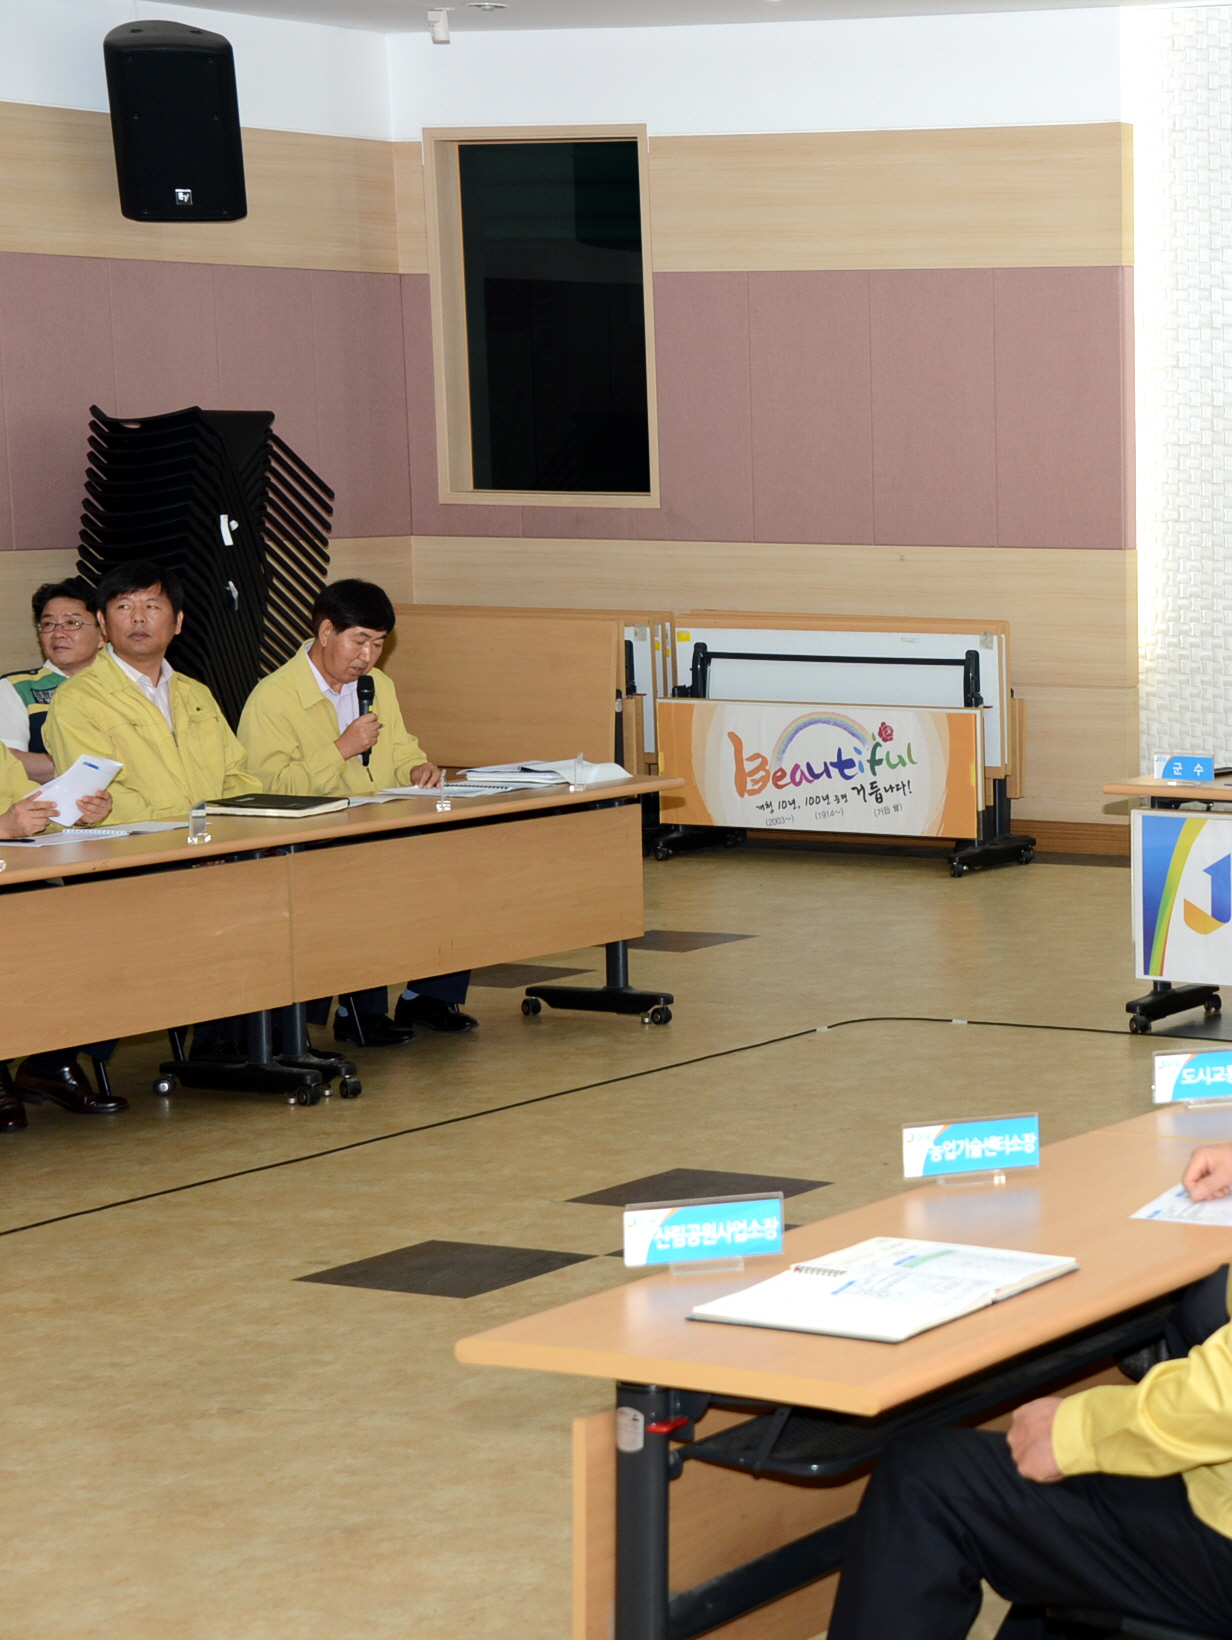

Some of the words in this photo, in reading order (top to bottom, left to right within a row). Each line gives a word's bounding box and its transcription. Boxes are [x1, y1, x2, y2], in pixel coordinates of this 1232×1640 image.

[727, 731, 918, 798] Beautiful
[804, 793, 831, 807] 100년
[928, 1132, 1037, 1162] 농업기술센터소장
[655, 1216, 780, 1249] 산림공원사업소장
